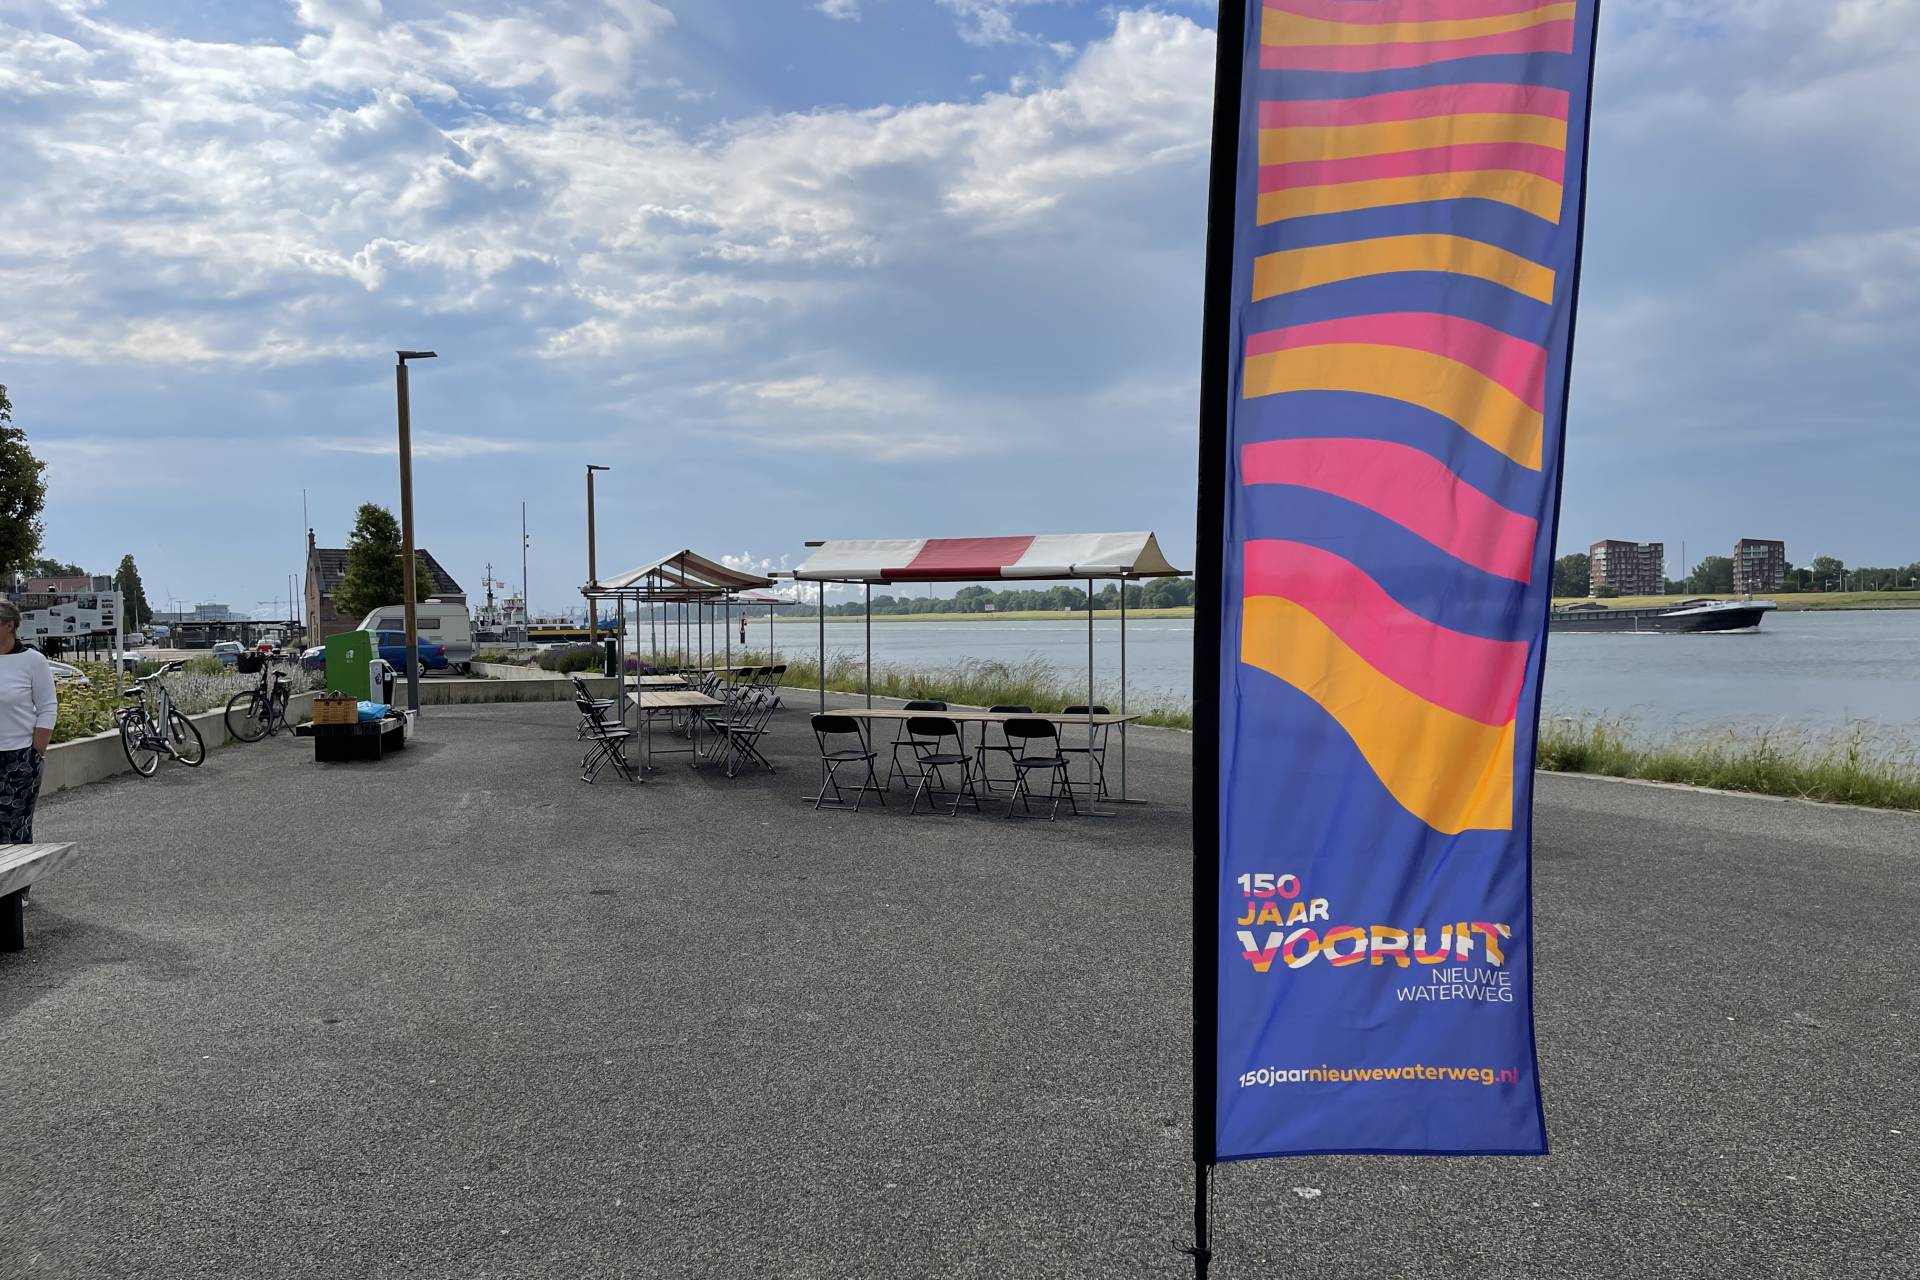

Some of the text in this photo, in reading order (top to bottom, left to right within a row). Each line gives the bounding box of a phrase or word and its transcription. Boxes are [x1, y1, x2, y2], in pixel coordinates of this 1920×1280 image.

[1237, 873, 1301, 898] 150
[1237, 898, 1329, 926] JAAR
[1236, 922, 1512, 972] VOORUIT
[1432, 967, 1511, 986] NIEUWE
[1397, 984, 1513, 1002] WATERWEG
[1239, 1064, 1518, 1088] 150jaarnieuwewaterweg.nl
